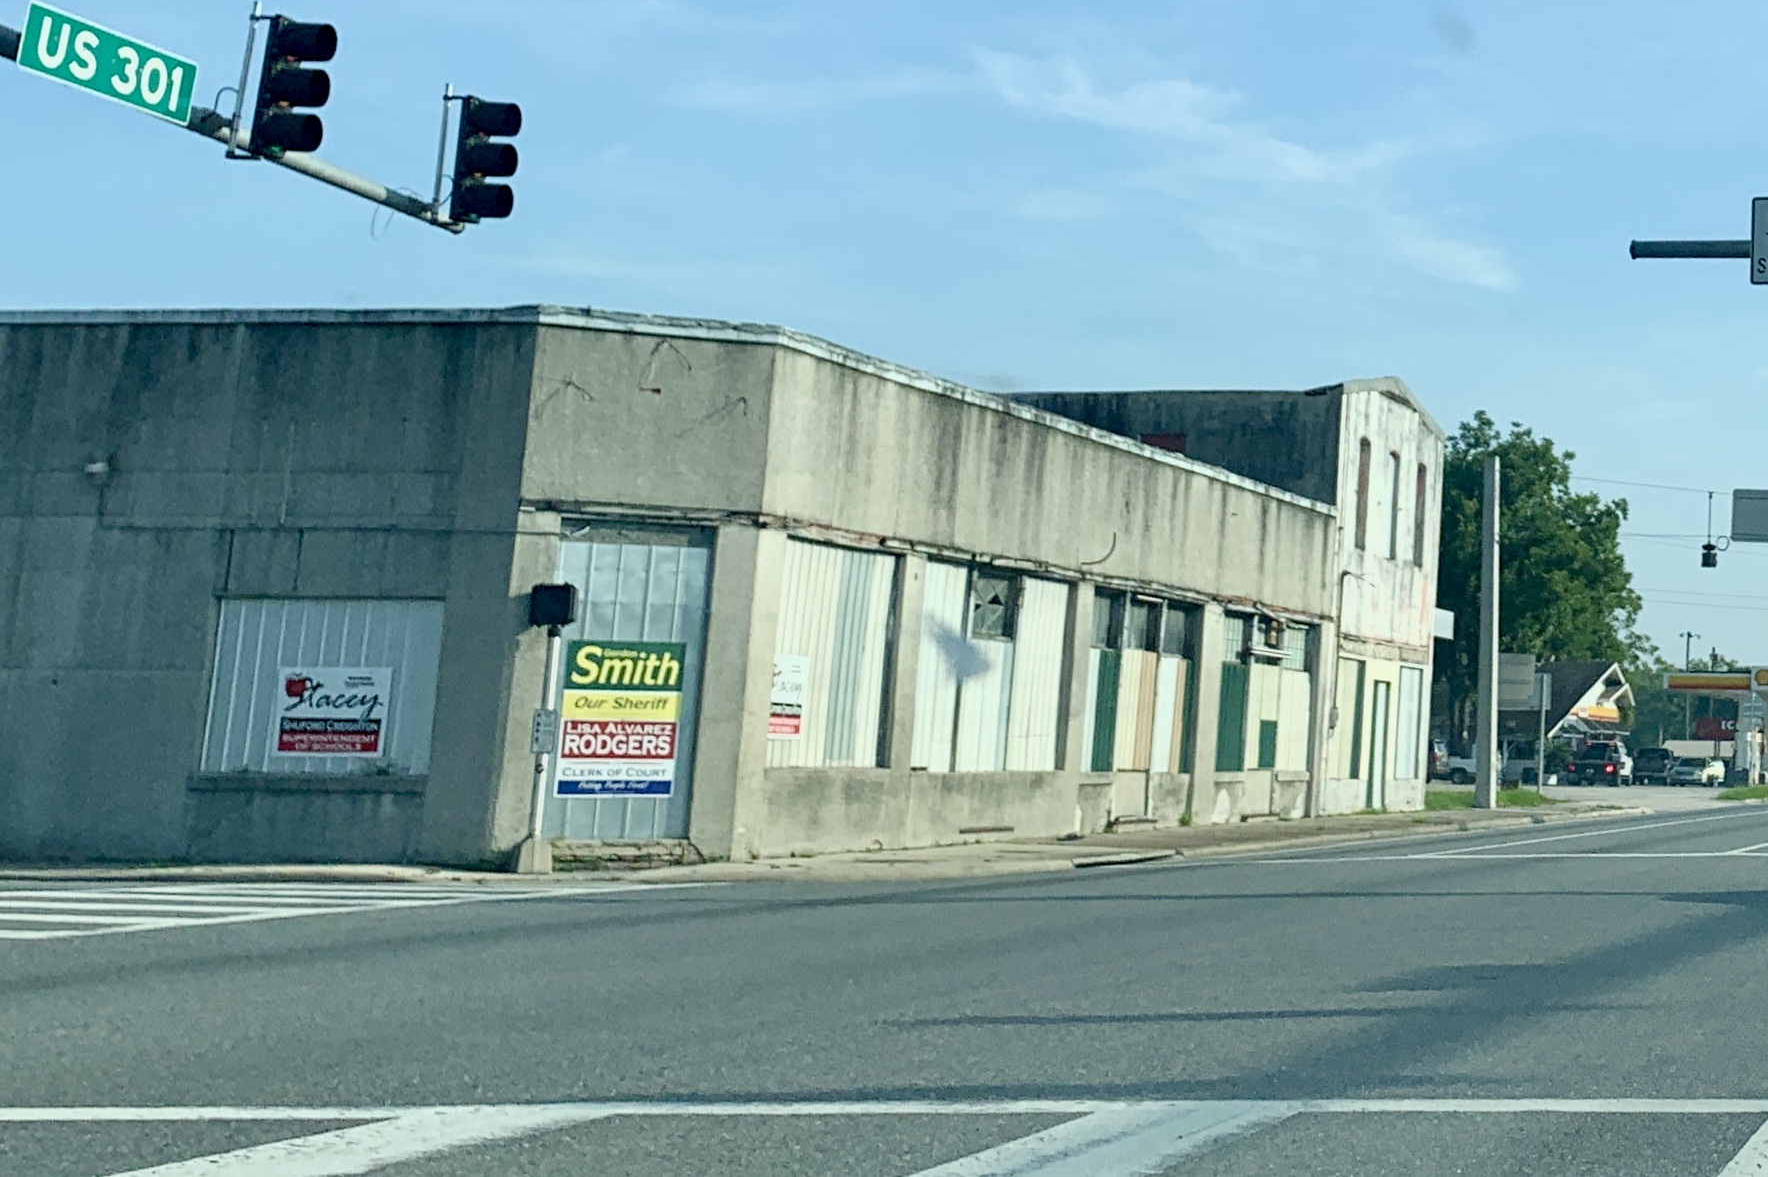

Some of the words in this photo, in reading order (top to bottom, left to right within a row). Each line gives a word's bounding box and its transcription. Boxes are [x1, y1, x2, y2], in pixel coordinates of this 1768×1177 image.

[37, 15, 100, 81] US
[110, 46, 184, 112] 301
[570, 645, 680, 685] Smith
[574, 697, 607, 709] Our
[612, 697, 670, 710] Sheriff
[567, 722, 602, 734] LISA
[605, 722, 672, 735] ALVAREZ
[563, 735, 671, 755] RODGERS
[562, 767, 603, 777] CLERK
[607, 768, 620, 777] OF
[625, 768, 667, 777] COURT
